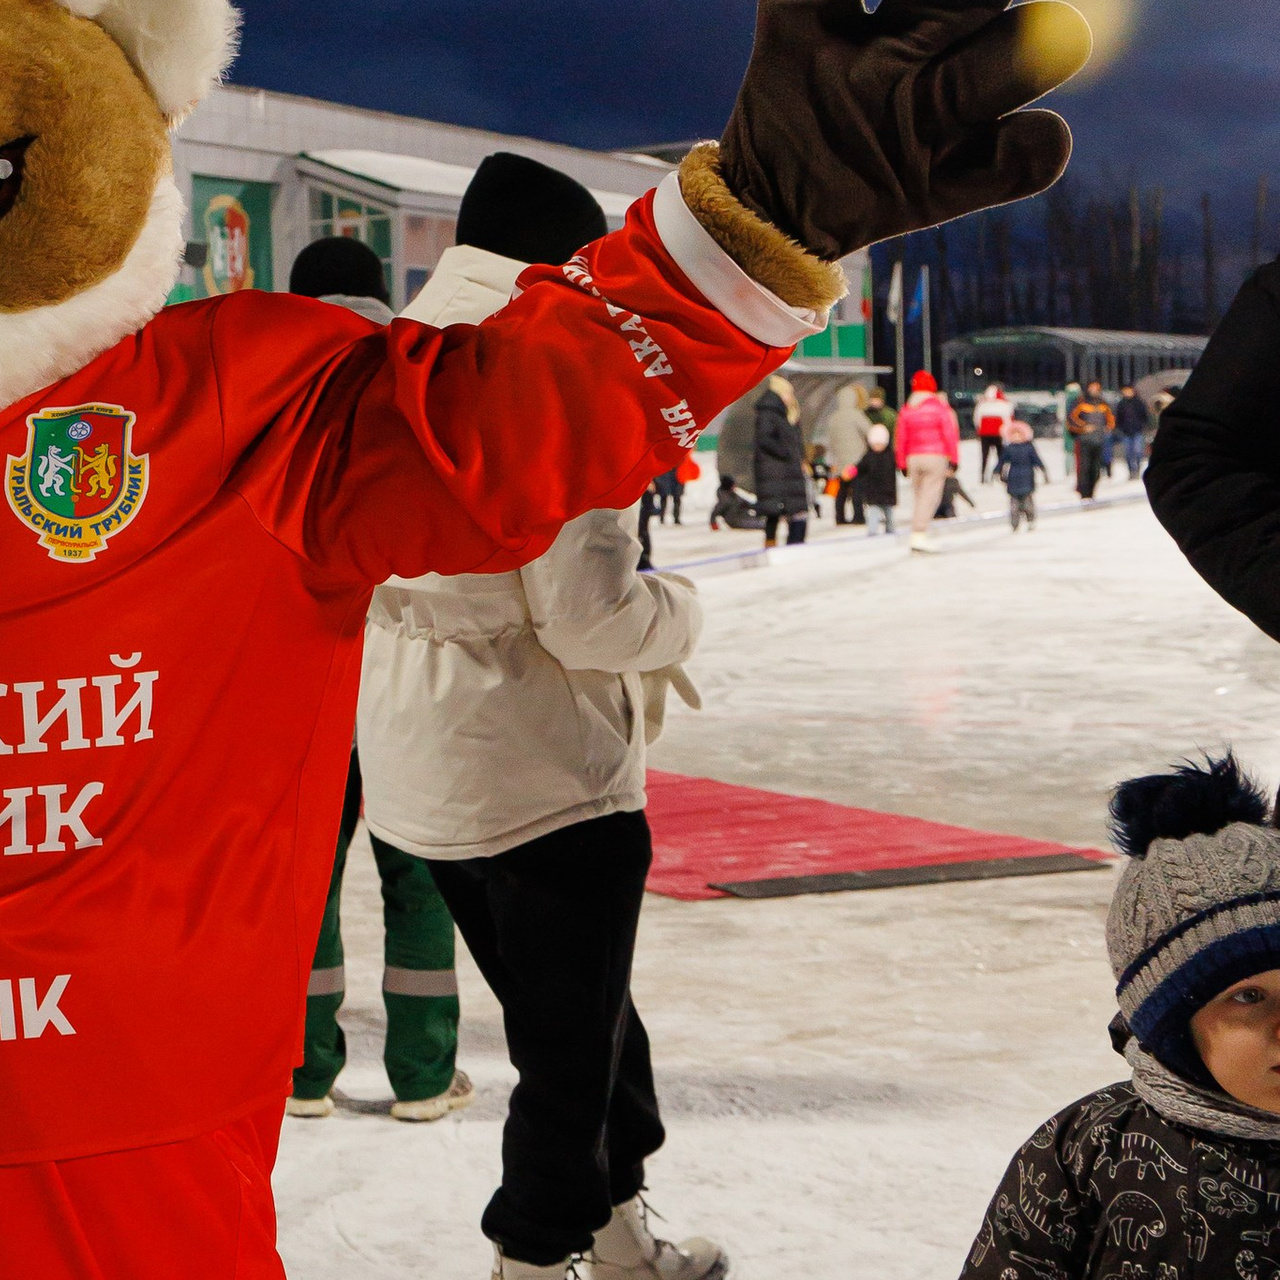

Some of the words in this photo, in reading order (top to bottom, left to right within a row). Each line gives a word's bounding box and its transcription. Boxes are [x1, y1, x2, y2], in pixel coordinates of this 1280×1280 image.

[11, 464, 83, 539] УРАЛЬСКИЙ
[89, 463, 142, 536] ТРУБНИК
[63, 549, 83, 557] 1937
